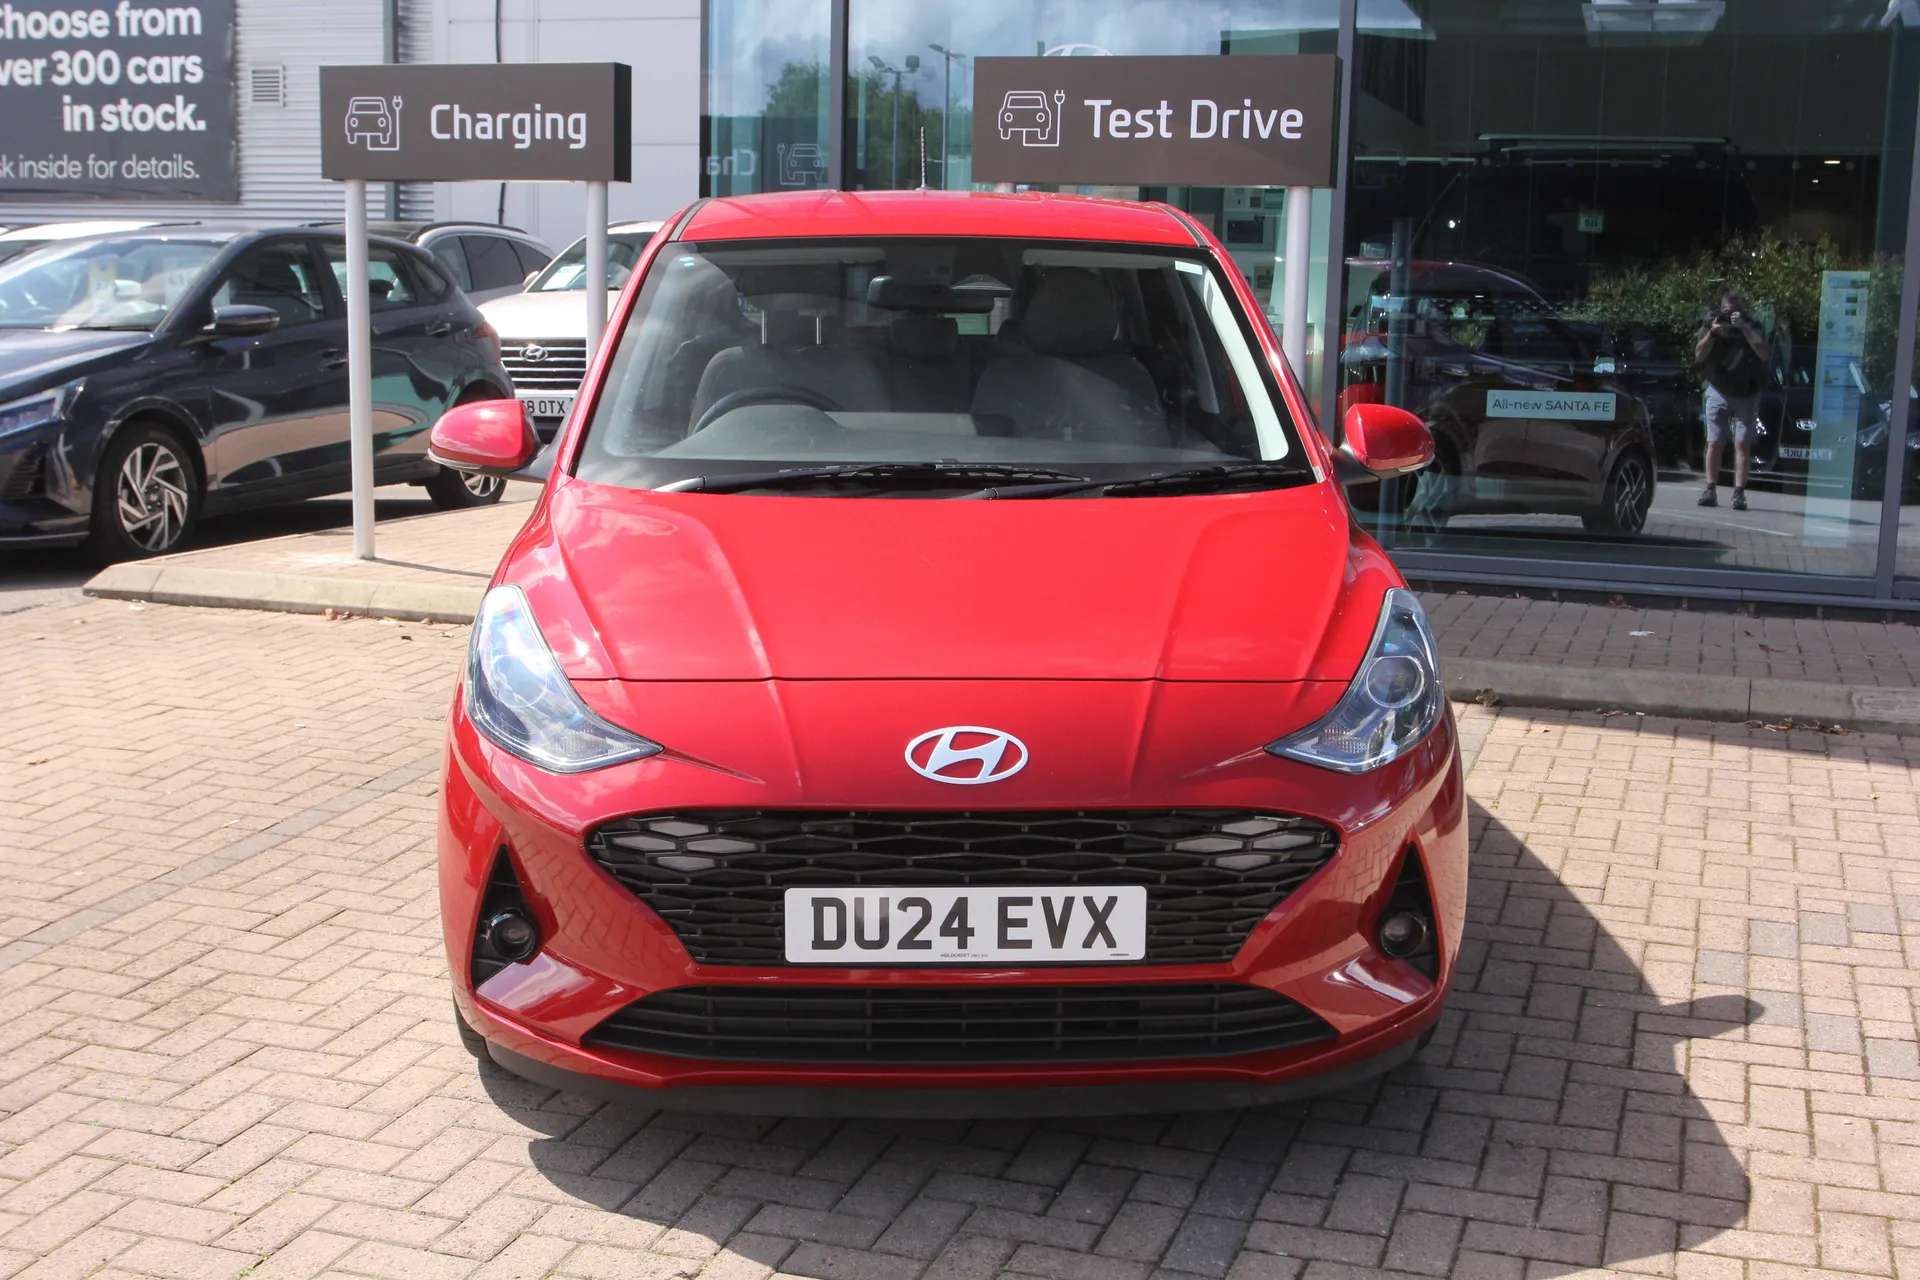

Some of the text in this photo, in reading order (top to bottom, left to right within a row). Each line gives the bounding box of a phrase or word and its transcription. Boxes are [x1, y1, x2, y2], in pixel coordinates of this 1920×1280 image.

[0, 1, 202, 39] hoose from
[51, 49, 121, 86] 300
[127, 54, 204, 84] cars
[62, 95, 207, 132] in stock.
[430, 103, 587, 149] Charging
[1084, 98, 1304, 139] Test Drive
[19, 153, 83, 179] inside
[87, 153, 116, 179] for
[121, 153, 200, 179] details.
[538, 400, 566, 414] OTX
[1492, 398, 1612, 412] All-new SANTA FE
[811, 895, 1118, 951] DU24 EVX
